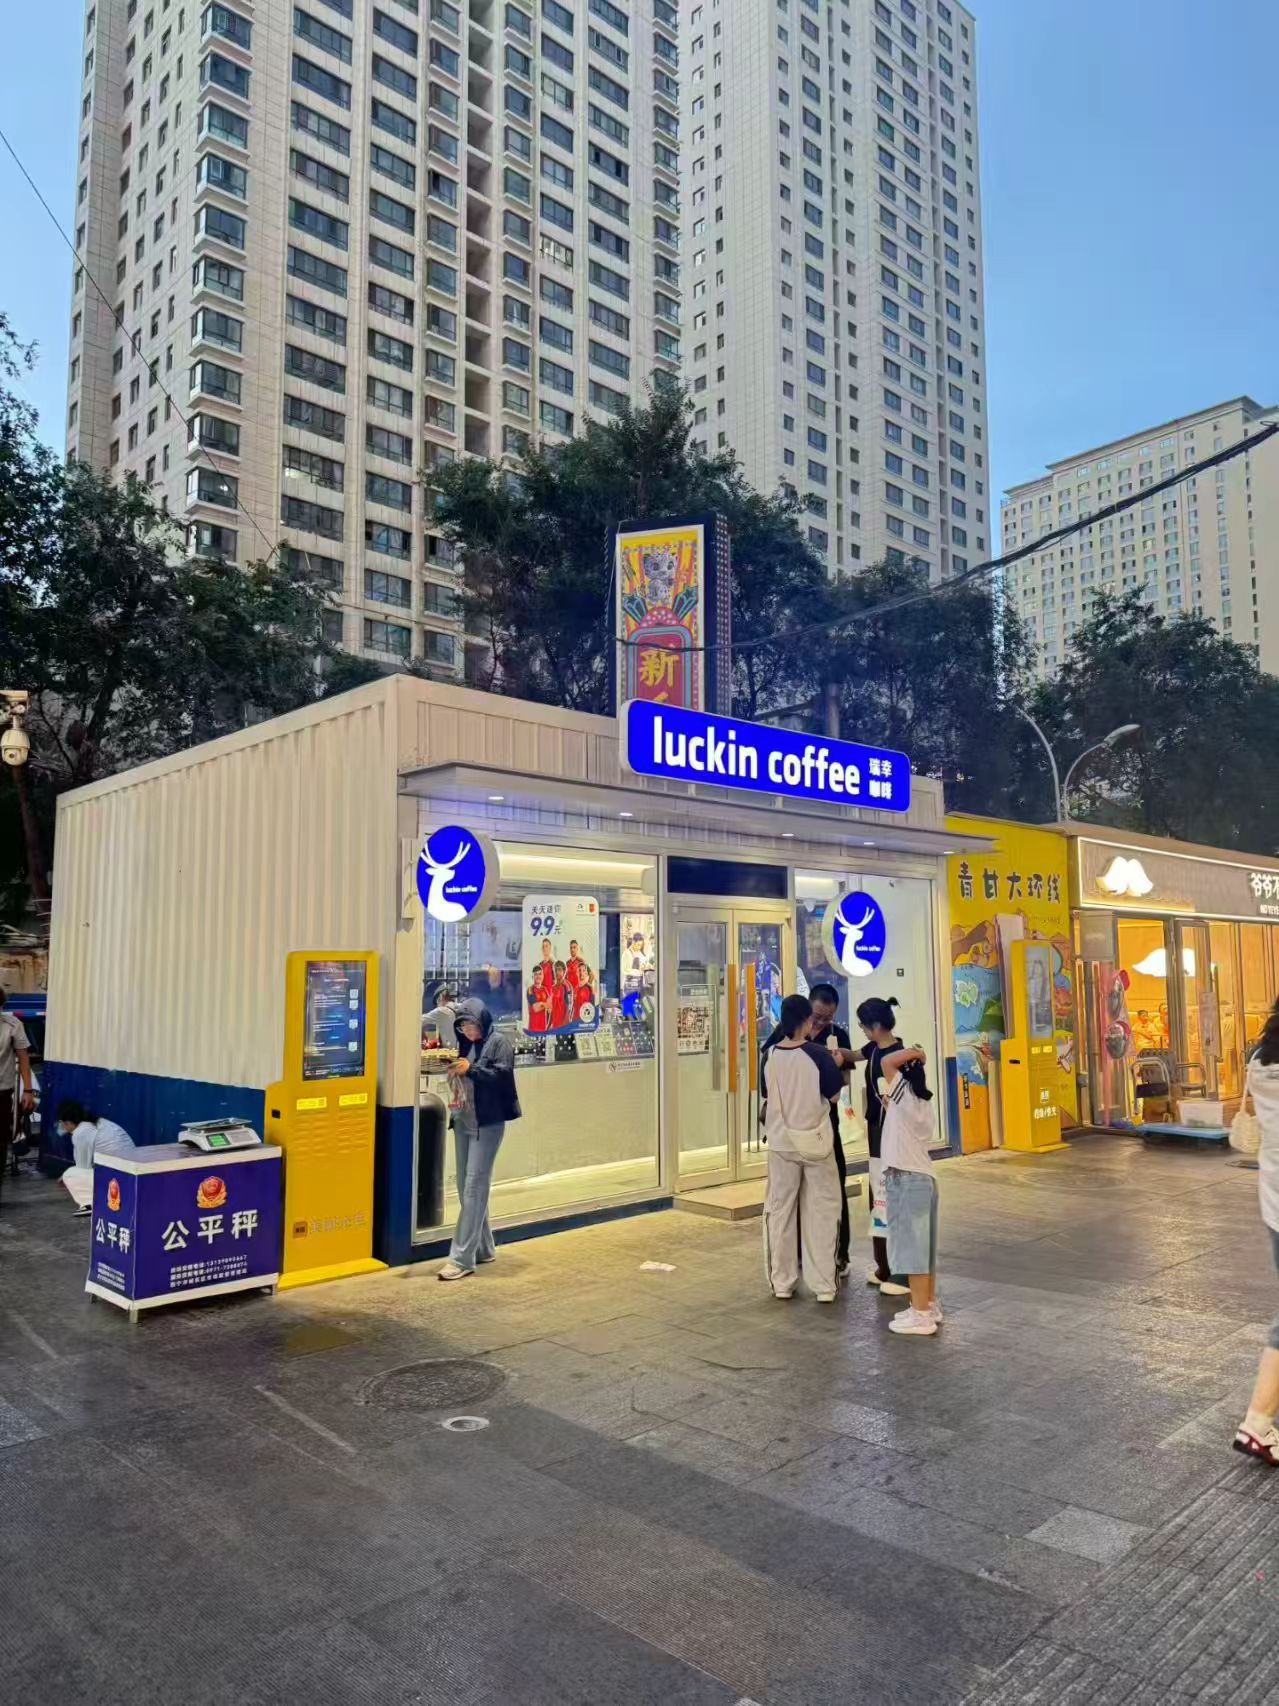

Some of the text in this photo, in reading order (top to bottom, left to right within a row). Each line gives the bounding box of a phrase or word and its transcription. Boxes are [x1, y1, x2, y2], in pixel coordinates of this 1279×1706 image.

[640, 650, 679, 701] 新
[653, 715, 860, 795] luckin coffee
[868, 757, 892, 778] 瑞幸
[868, 780, 892, 800] 咖啡
[958, 861, 1060, 904] 青甘大环线
[94, 1217, 131, 1255] 公平秤
[161, 1209, 259, 1251] 公平秤
